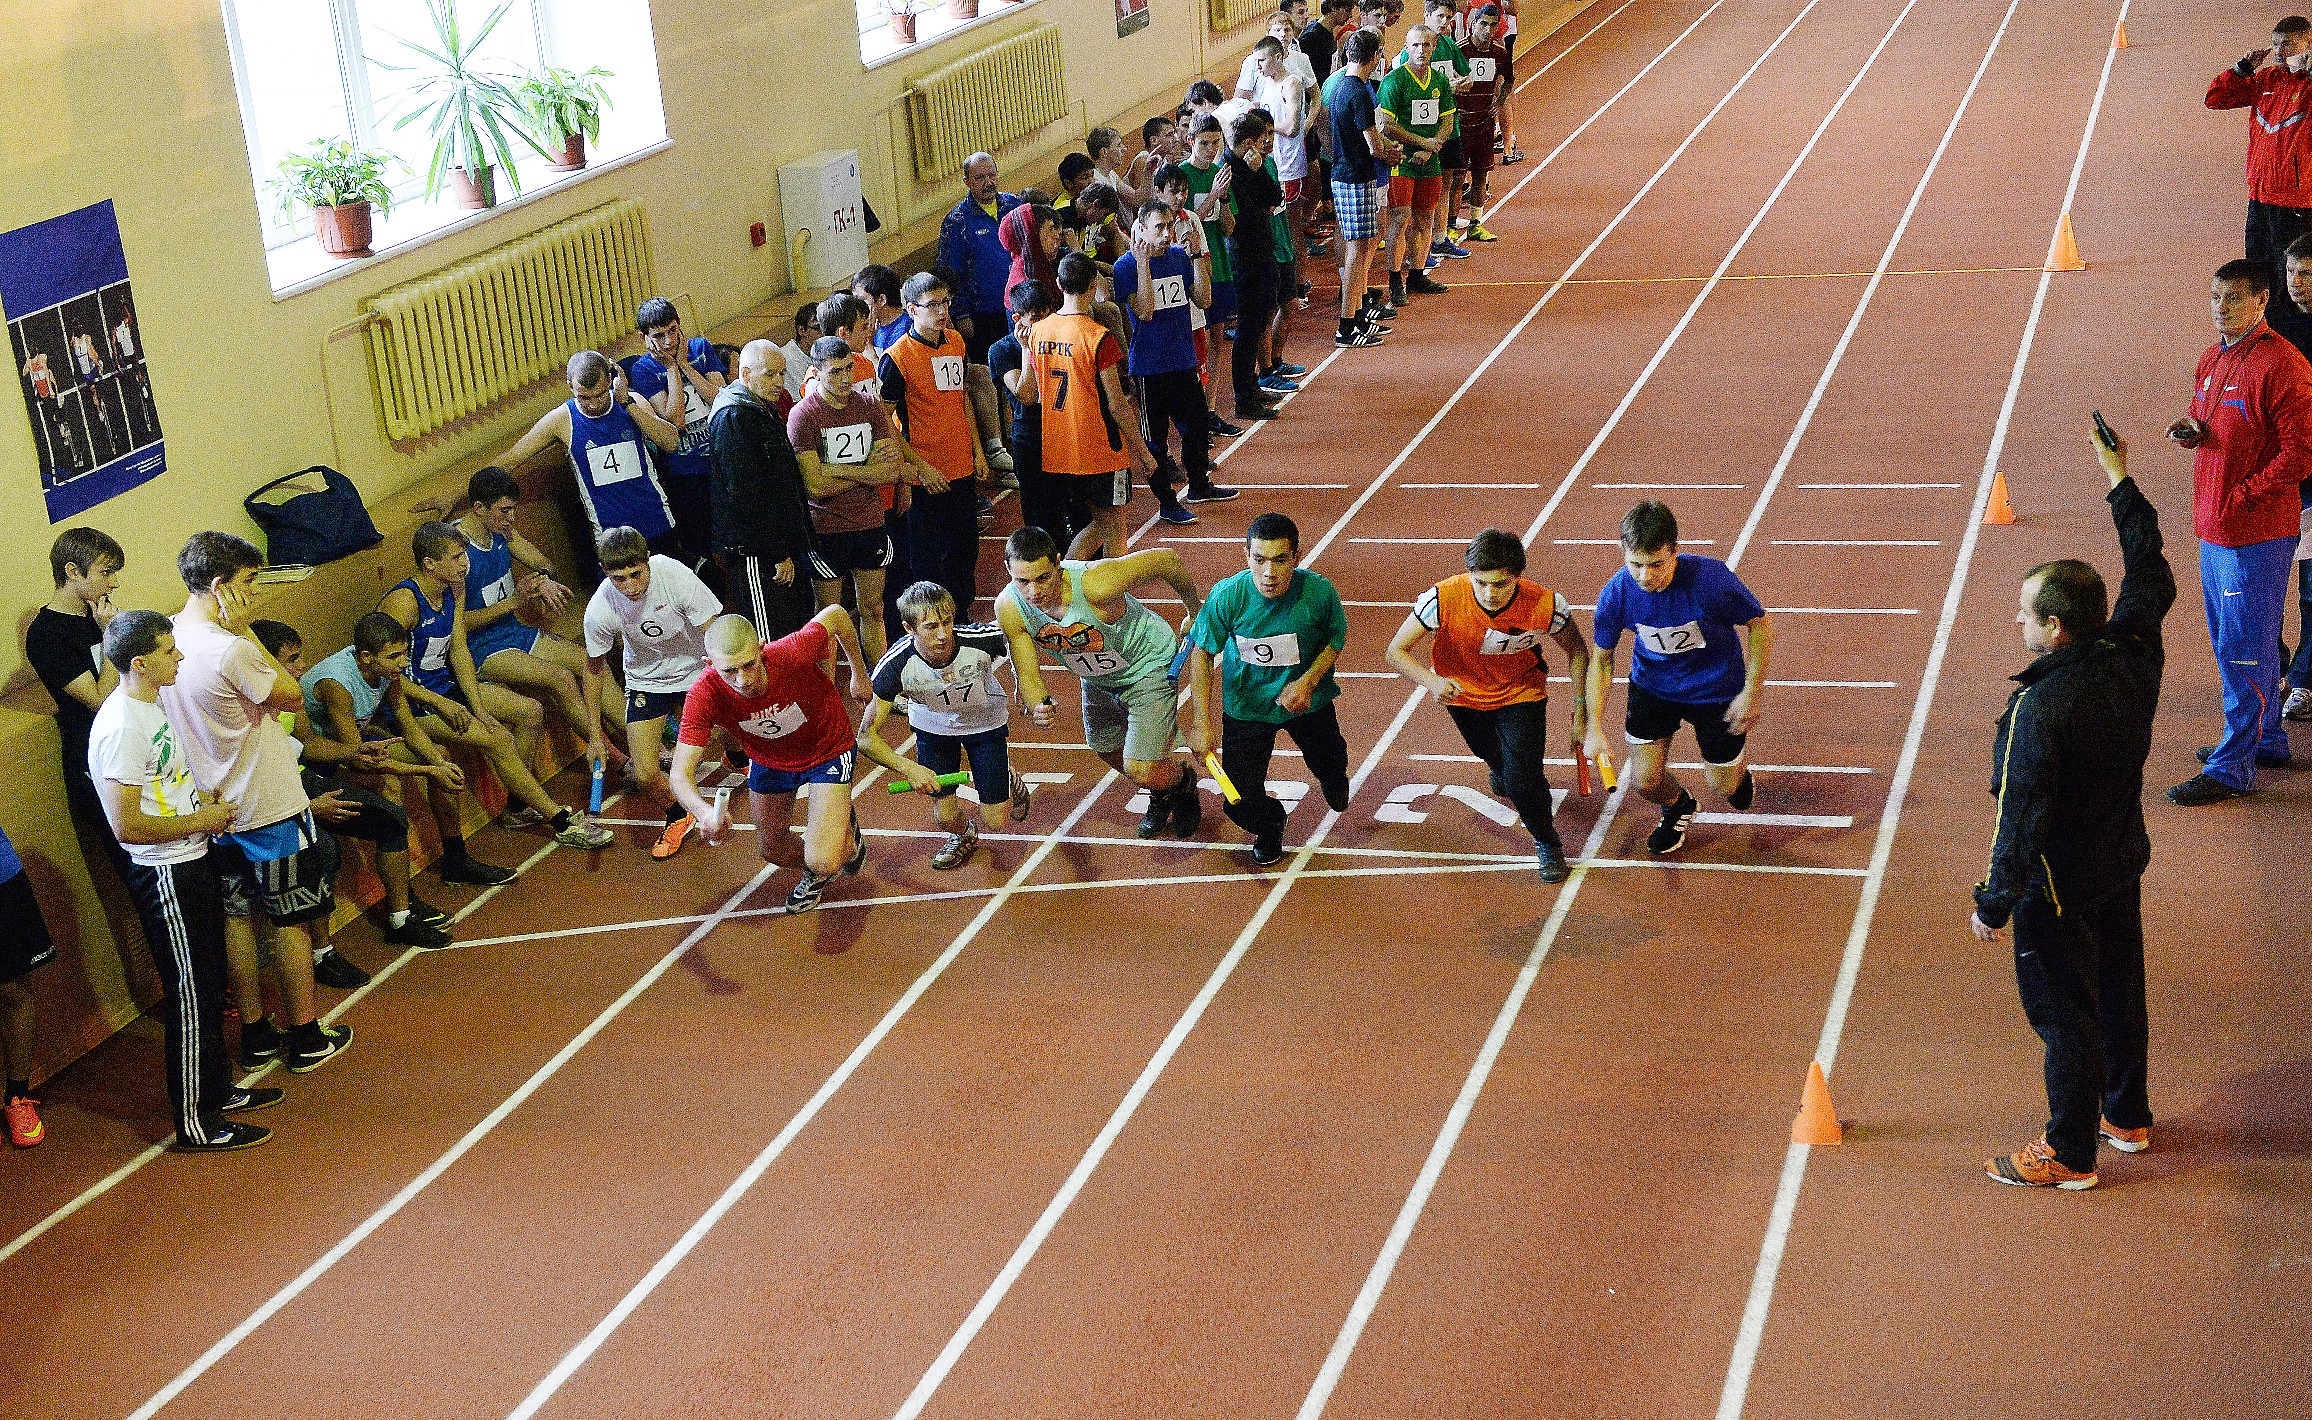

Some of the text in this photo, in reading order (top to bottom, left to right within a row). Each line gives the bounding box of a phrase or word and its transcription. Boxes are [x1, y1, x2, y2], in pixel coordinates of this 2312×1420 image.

[1476, 60, 1486, 77] 6
[1419, 102, 1431, 120] 3
[1157, 281, 1183, 306] 12
[940, 361, 962, 387] 13
[1049, 367, 1070, 412] 7
[835, 430, 866, 459] 21
[602, 448, 621, 474] 4
[640, 620, 664, 638] 6
[1496, 633, 1535, 653] 13
[1650, 630, 1696, 652] 12
[1075, 652, 1117, 673] 15
[1253, 643, 1274, 664] 9
[936, 682, 974, 706] 17
[757, 719, 782, 735] 3
